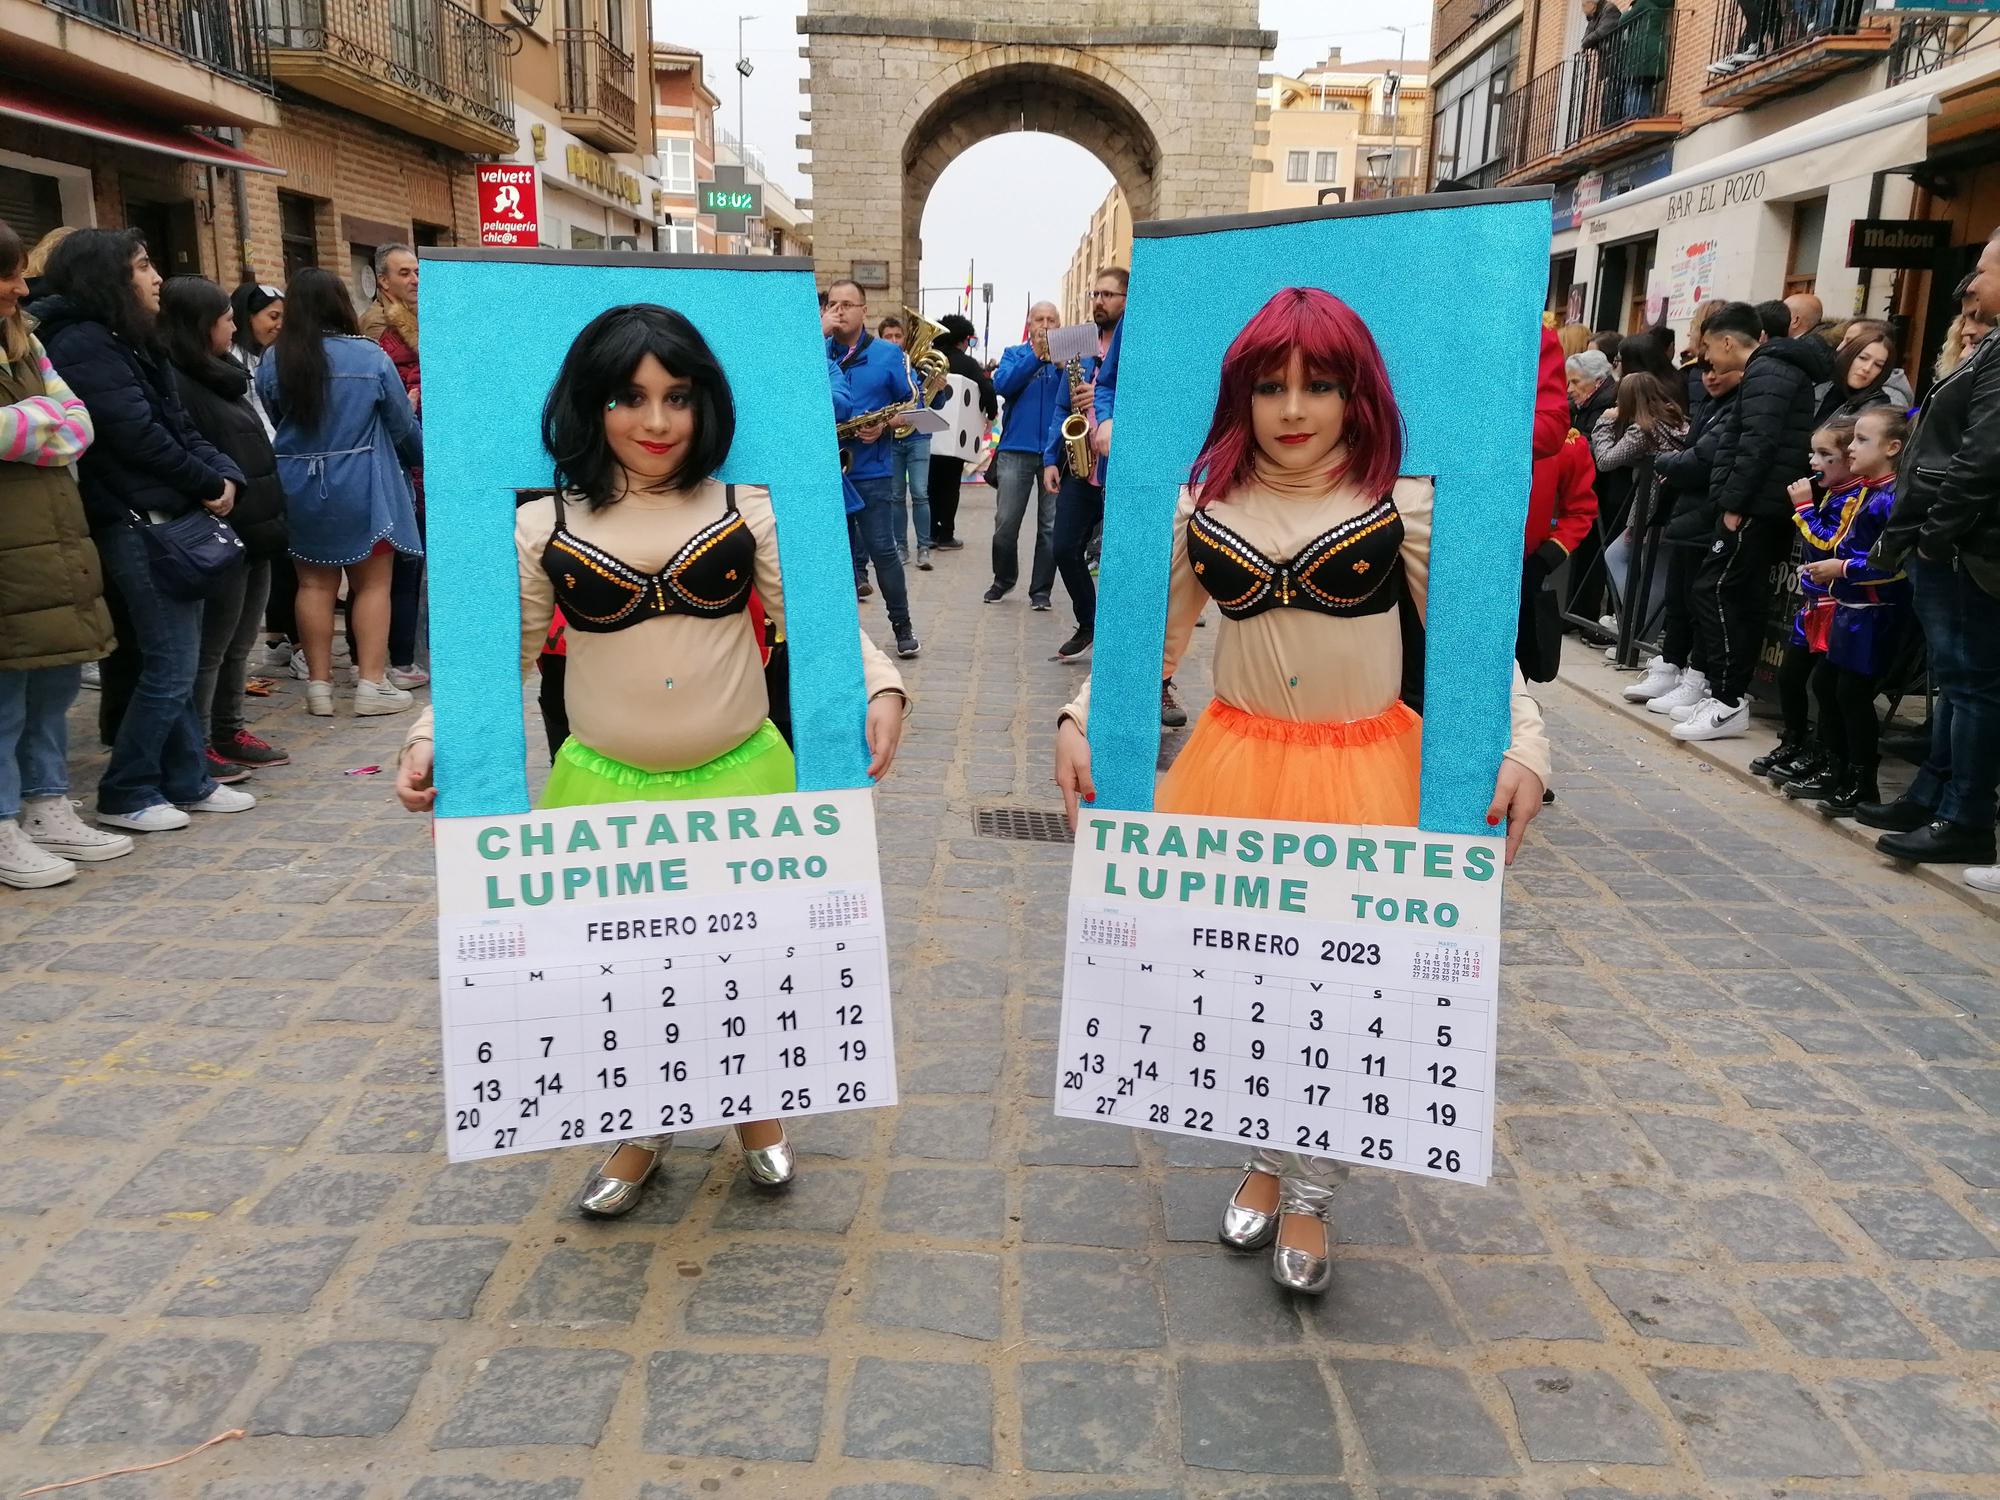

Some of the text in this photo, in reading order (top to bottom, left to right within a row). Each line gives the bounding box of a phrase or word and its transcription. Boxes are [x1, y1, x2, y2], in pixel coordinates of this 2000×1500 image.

[481, 168, 532, 184] velvett
[707, 191, 753, 209] 18:02
[1667, 170, 1766, 222] BAR EL POZO
[482, 231, 518, 244] chic@s
[1863, 227, 1935, 249] Mahou
[477, 805, 841, 860] CHATARRAS
[1090, 819, 1495, 881] TRANSPORTES
[485, 855, 827, 907] LUPIME TORO
[1105, 863, 1459, 926] LUPIME TORO
[588, 912, 756, 942] FEBRERO 2023
[1194, 928, 1380, 965] FEBRERO 2023
[465, 943, 845, 986] L M X J V S D
[602, 968, 853, 1012] 1 2 3 4 5
[1088, 957, 1450, 1006] L M X J V S D
[478, 1005, 863, 1063] 6 7 8 9 10 11 12
[1193, 995, 1451, 1047] 1 2 3 4 5
[474, 1040, 866, 1102] 13 14 15 16 17 18 19
[1087, 1018, 1456, 1088] 6 7 8 9 10 11 12
[457, 1082, 865, 1133] 20 21 22 23 24 25 26
[1080, 1053, 1456, 1126] 13 14 15 16 17 18 19
[1096, 1096, 1169, 1123] 27 28
[495, 1119, 584, 1149] 27 28
[1064, 1071, 1460, 1172] 20 21 22 23 24 25 26
